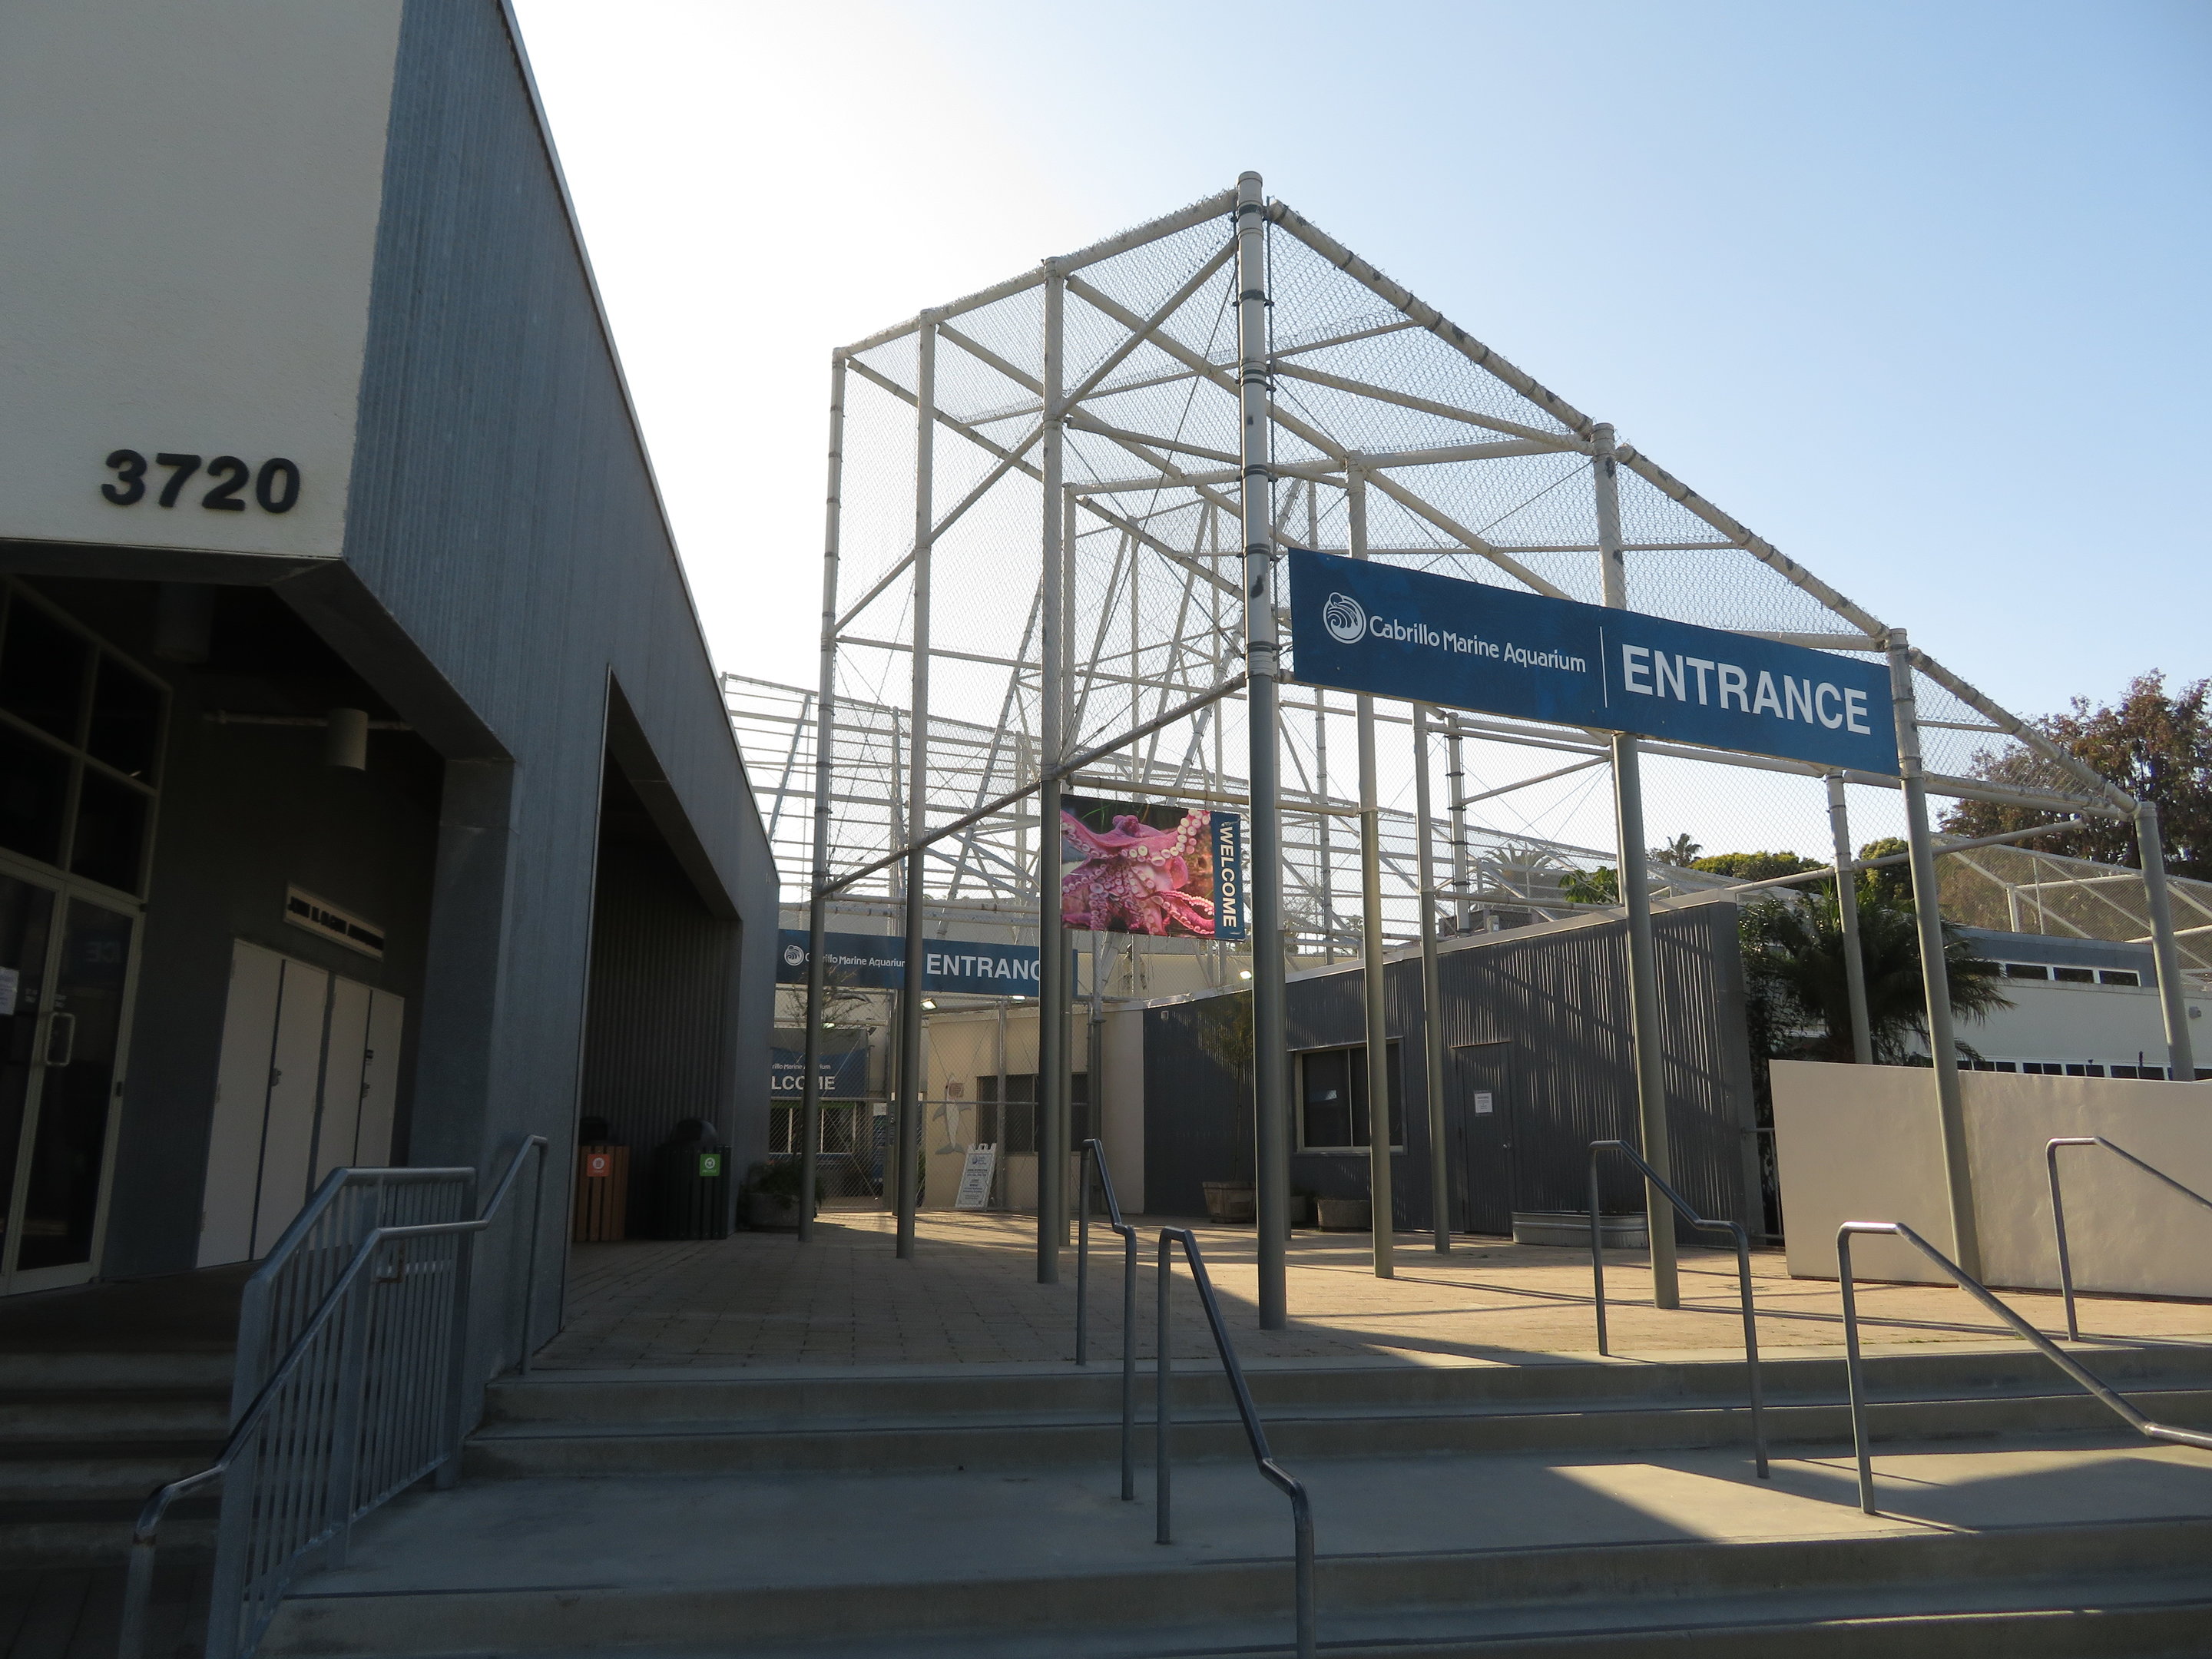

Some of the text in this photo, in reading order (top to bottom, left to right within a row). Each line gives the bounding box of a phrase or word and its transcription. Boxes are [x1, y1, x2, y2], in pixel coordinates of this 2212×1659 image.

[101, 449, 300, 514] 3720
[1369, 614, 1586, 673] Cabrillo Marine Aquarium
[1621, 644, 1871, 735] ENTRANCE
[1220, 826, 1237, 928] WELCOME
[805, 952, 838, 964] Crillo
[839, 955, 866, 965] Marine
